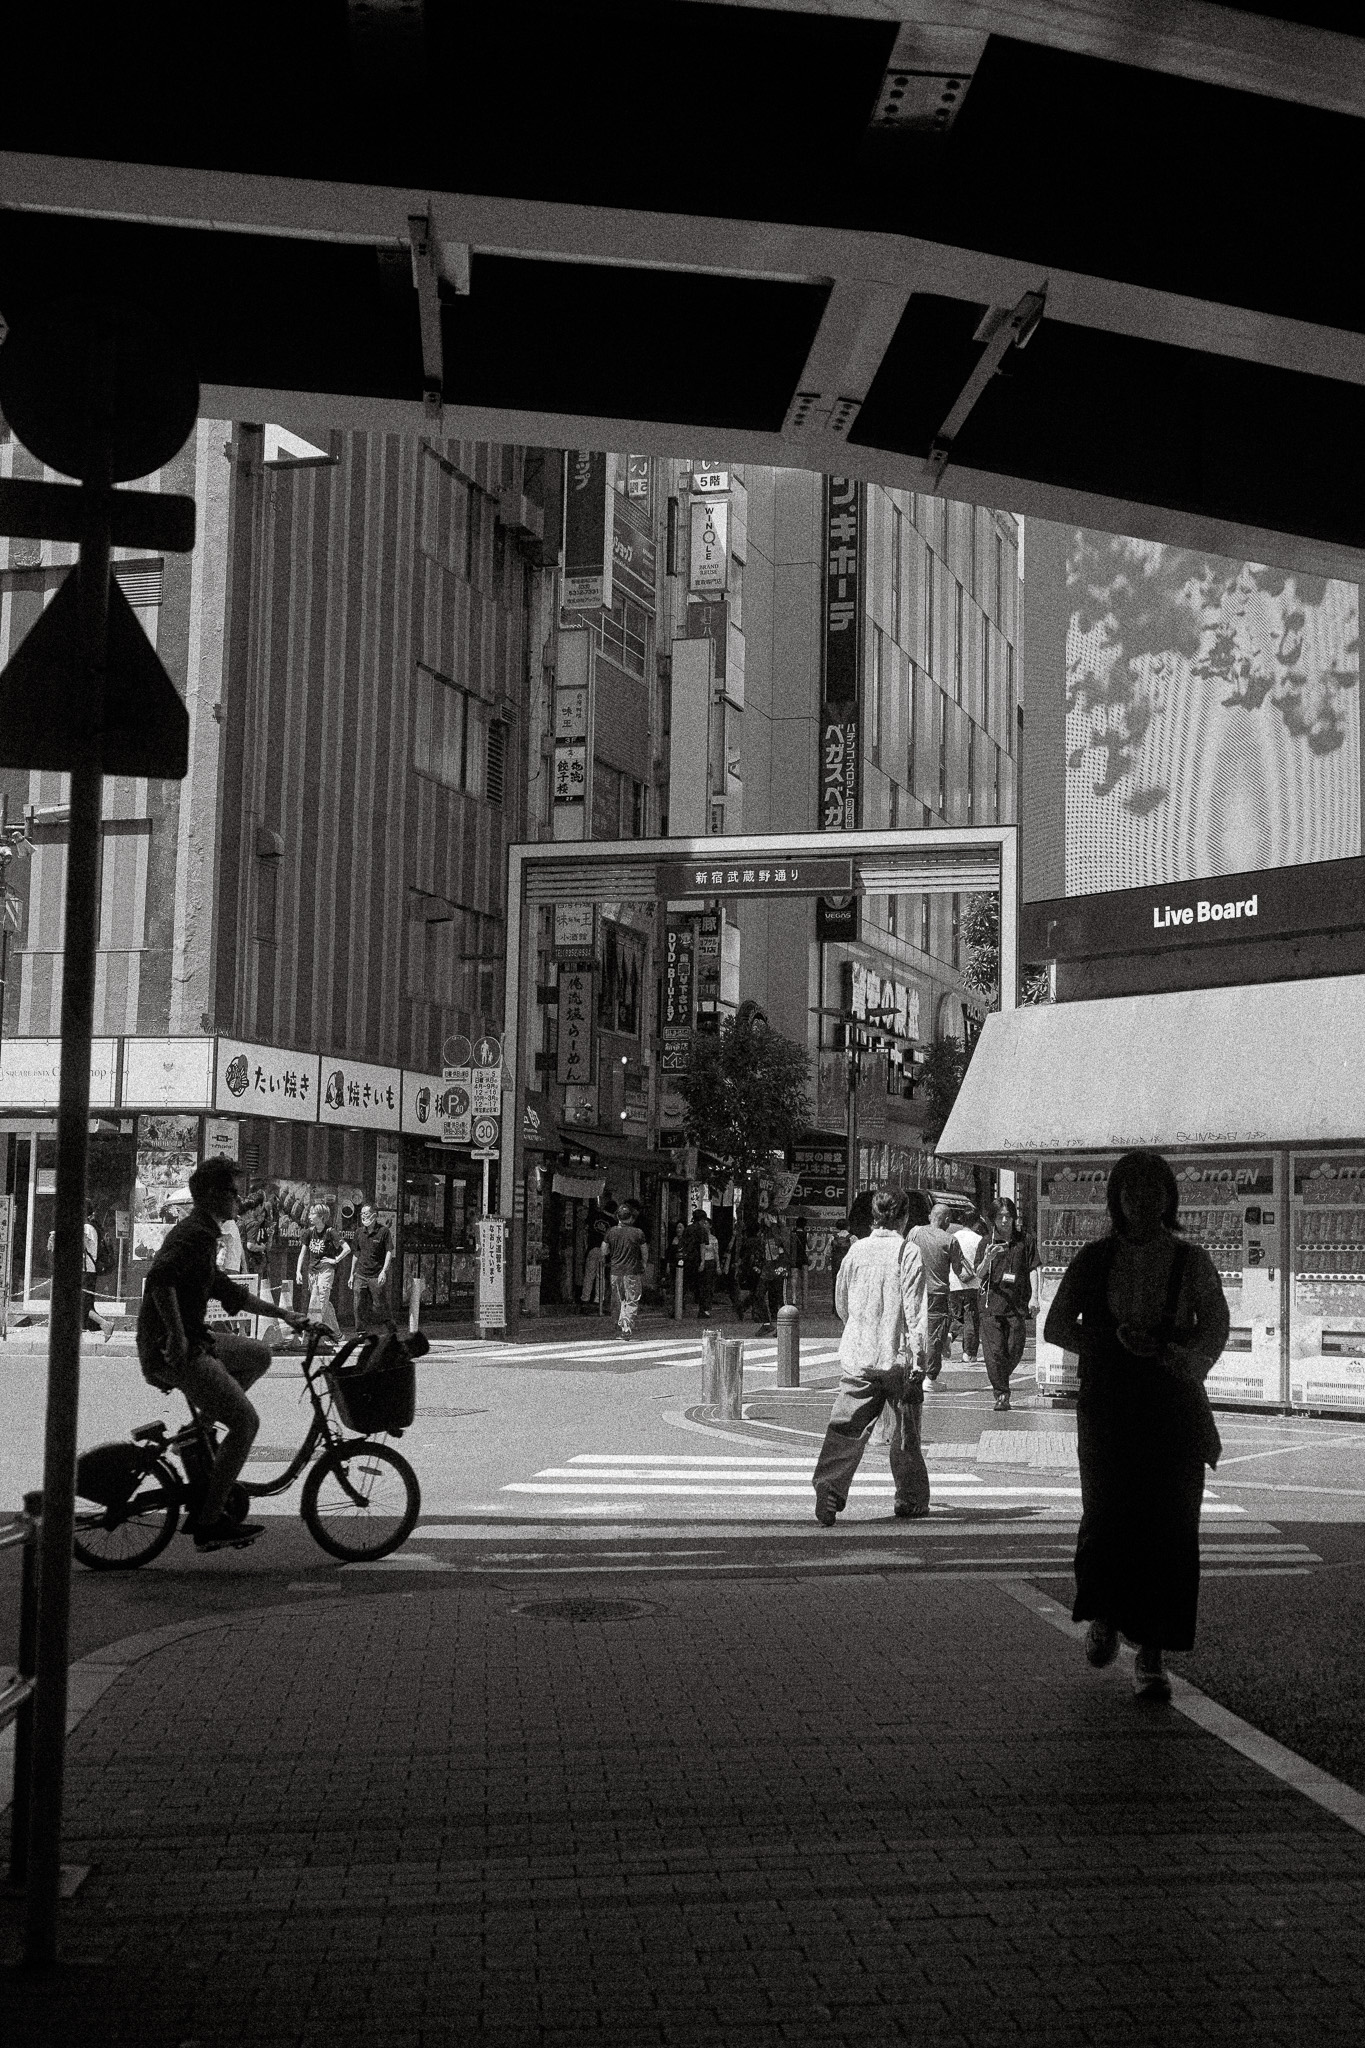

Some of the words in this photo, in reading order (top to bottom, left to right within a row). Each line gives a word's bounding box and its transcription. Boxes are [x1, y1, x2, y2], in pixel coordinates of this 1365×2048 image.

[700, 475, 720, 487] 5階
[824, 724, 845, 830] ベガスベガ
[695, 869, 799, 885] 新宿武蔵野通り
[825, 911, 851, 920] VEGAS
[1153, 905, 1194, 929] Live
[1197, 894, 1259, 923] Board
[254, 1065, 310, 1101] たい焼き
[347, 1080, 395, 1110] 焼きいも
[448, 1094, 460, 1114] P
[477, 1125, 493, 1139] 30
[1234, 1168, 1260, 1185] EN
